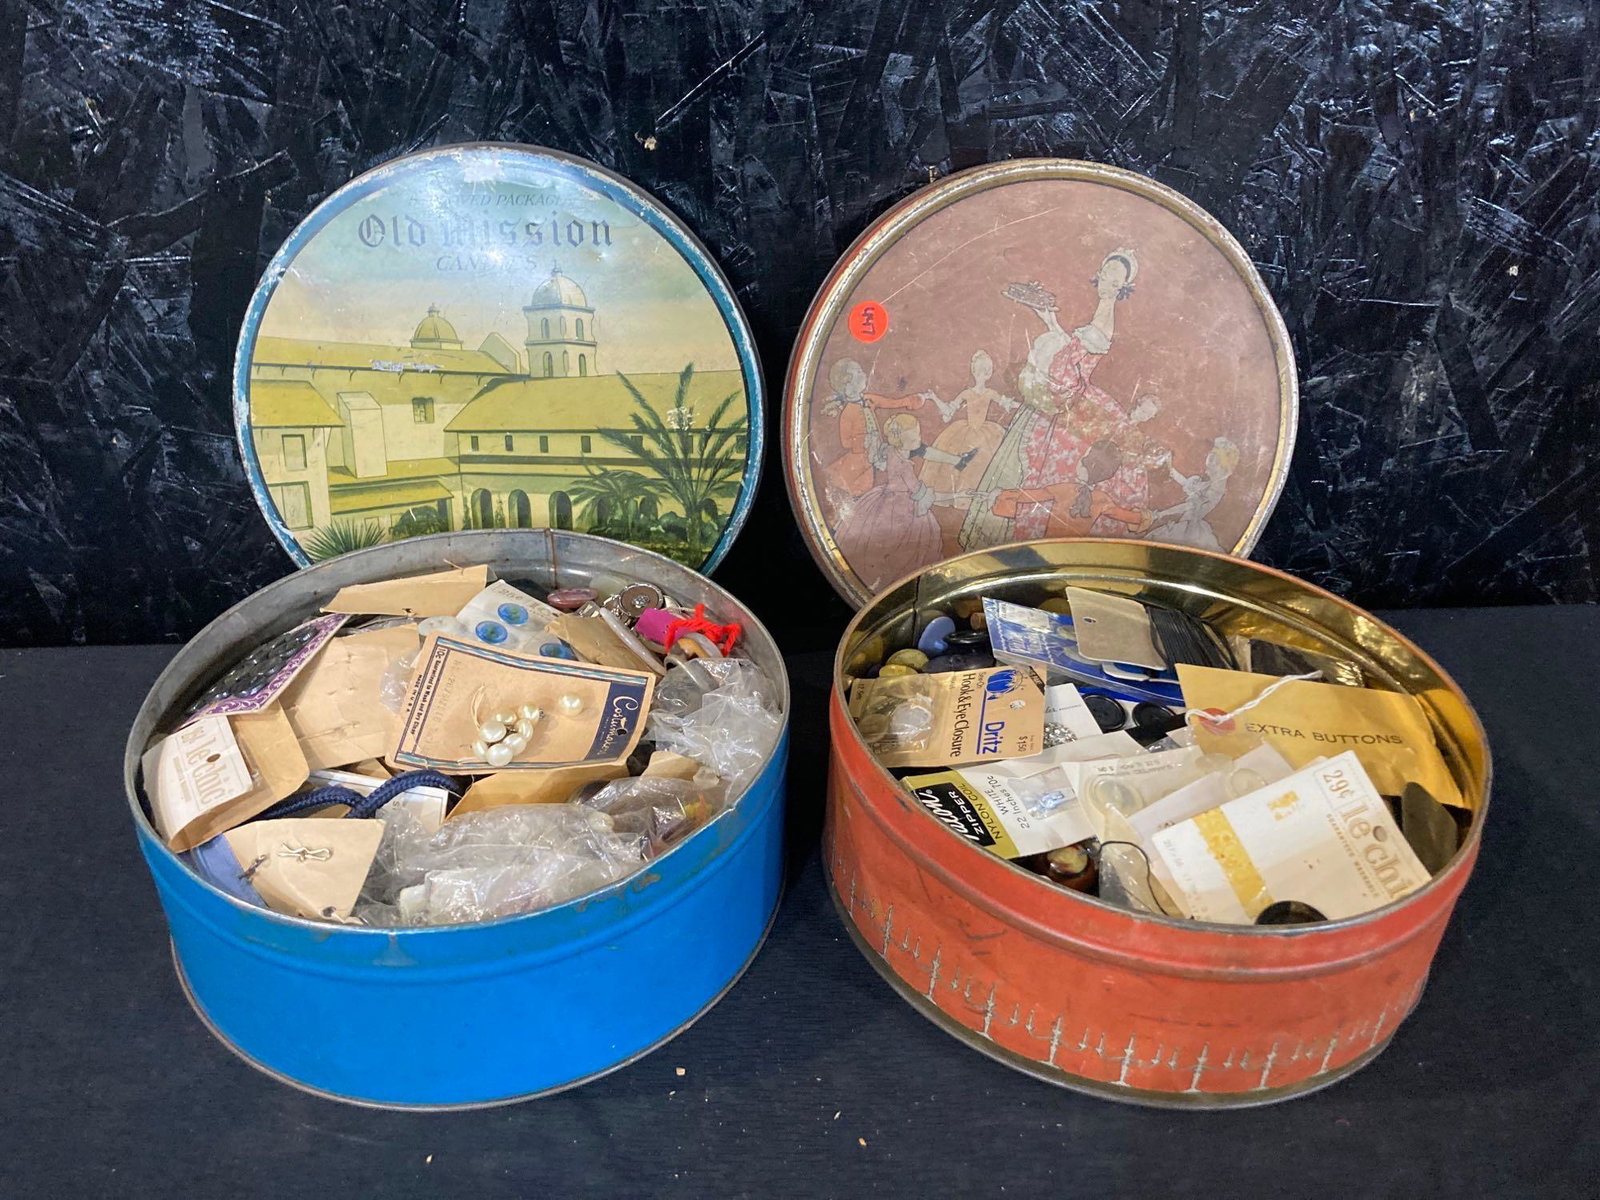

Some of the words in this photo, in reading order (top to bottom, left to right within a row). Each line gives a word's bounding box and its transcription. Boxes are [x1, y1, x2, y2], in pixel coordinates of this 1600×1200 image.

[357, 213, 427, 248] Old
[950, 720, 969, 758] Closure
[982, 721, 1005, 754] Dritz
[1246, 722, 1307, 740] EXTRA
[1312, 731, 1404, 745] BUTTONS
[958, 783, 979, 802] COIL
[984, 788, 1009, 816] WHITE
[1000, 789, 1021, 815] Inches
[948, 782, 985, 835] ZIPPER
[975, 803, 1004, 840] NYLON
[1016, 816, 1030, 829] 22
